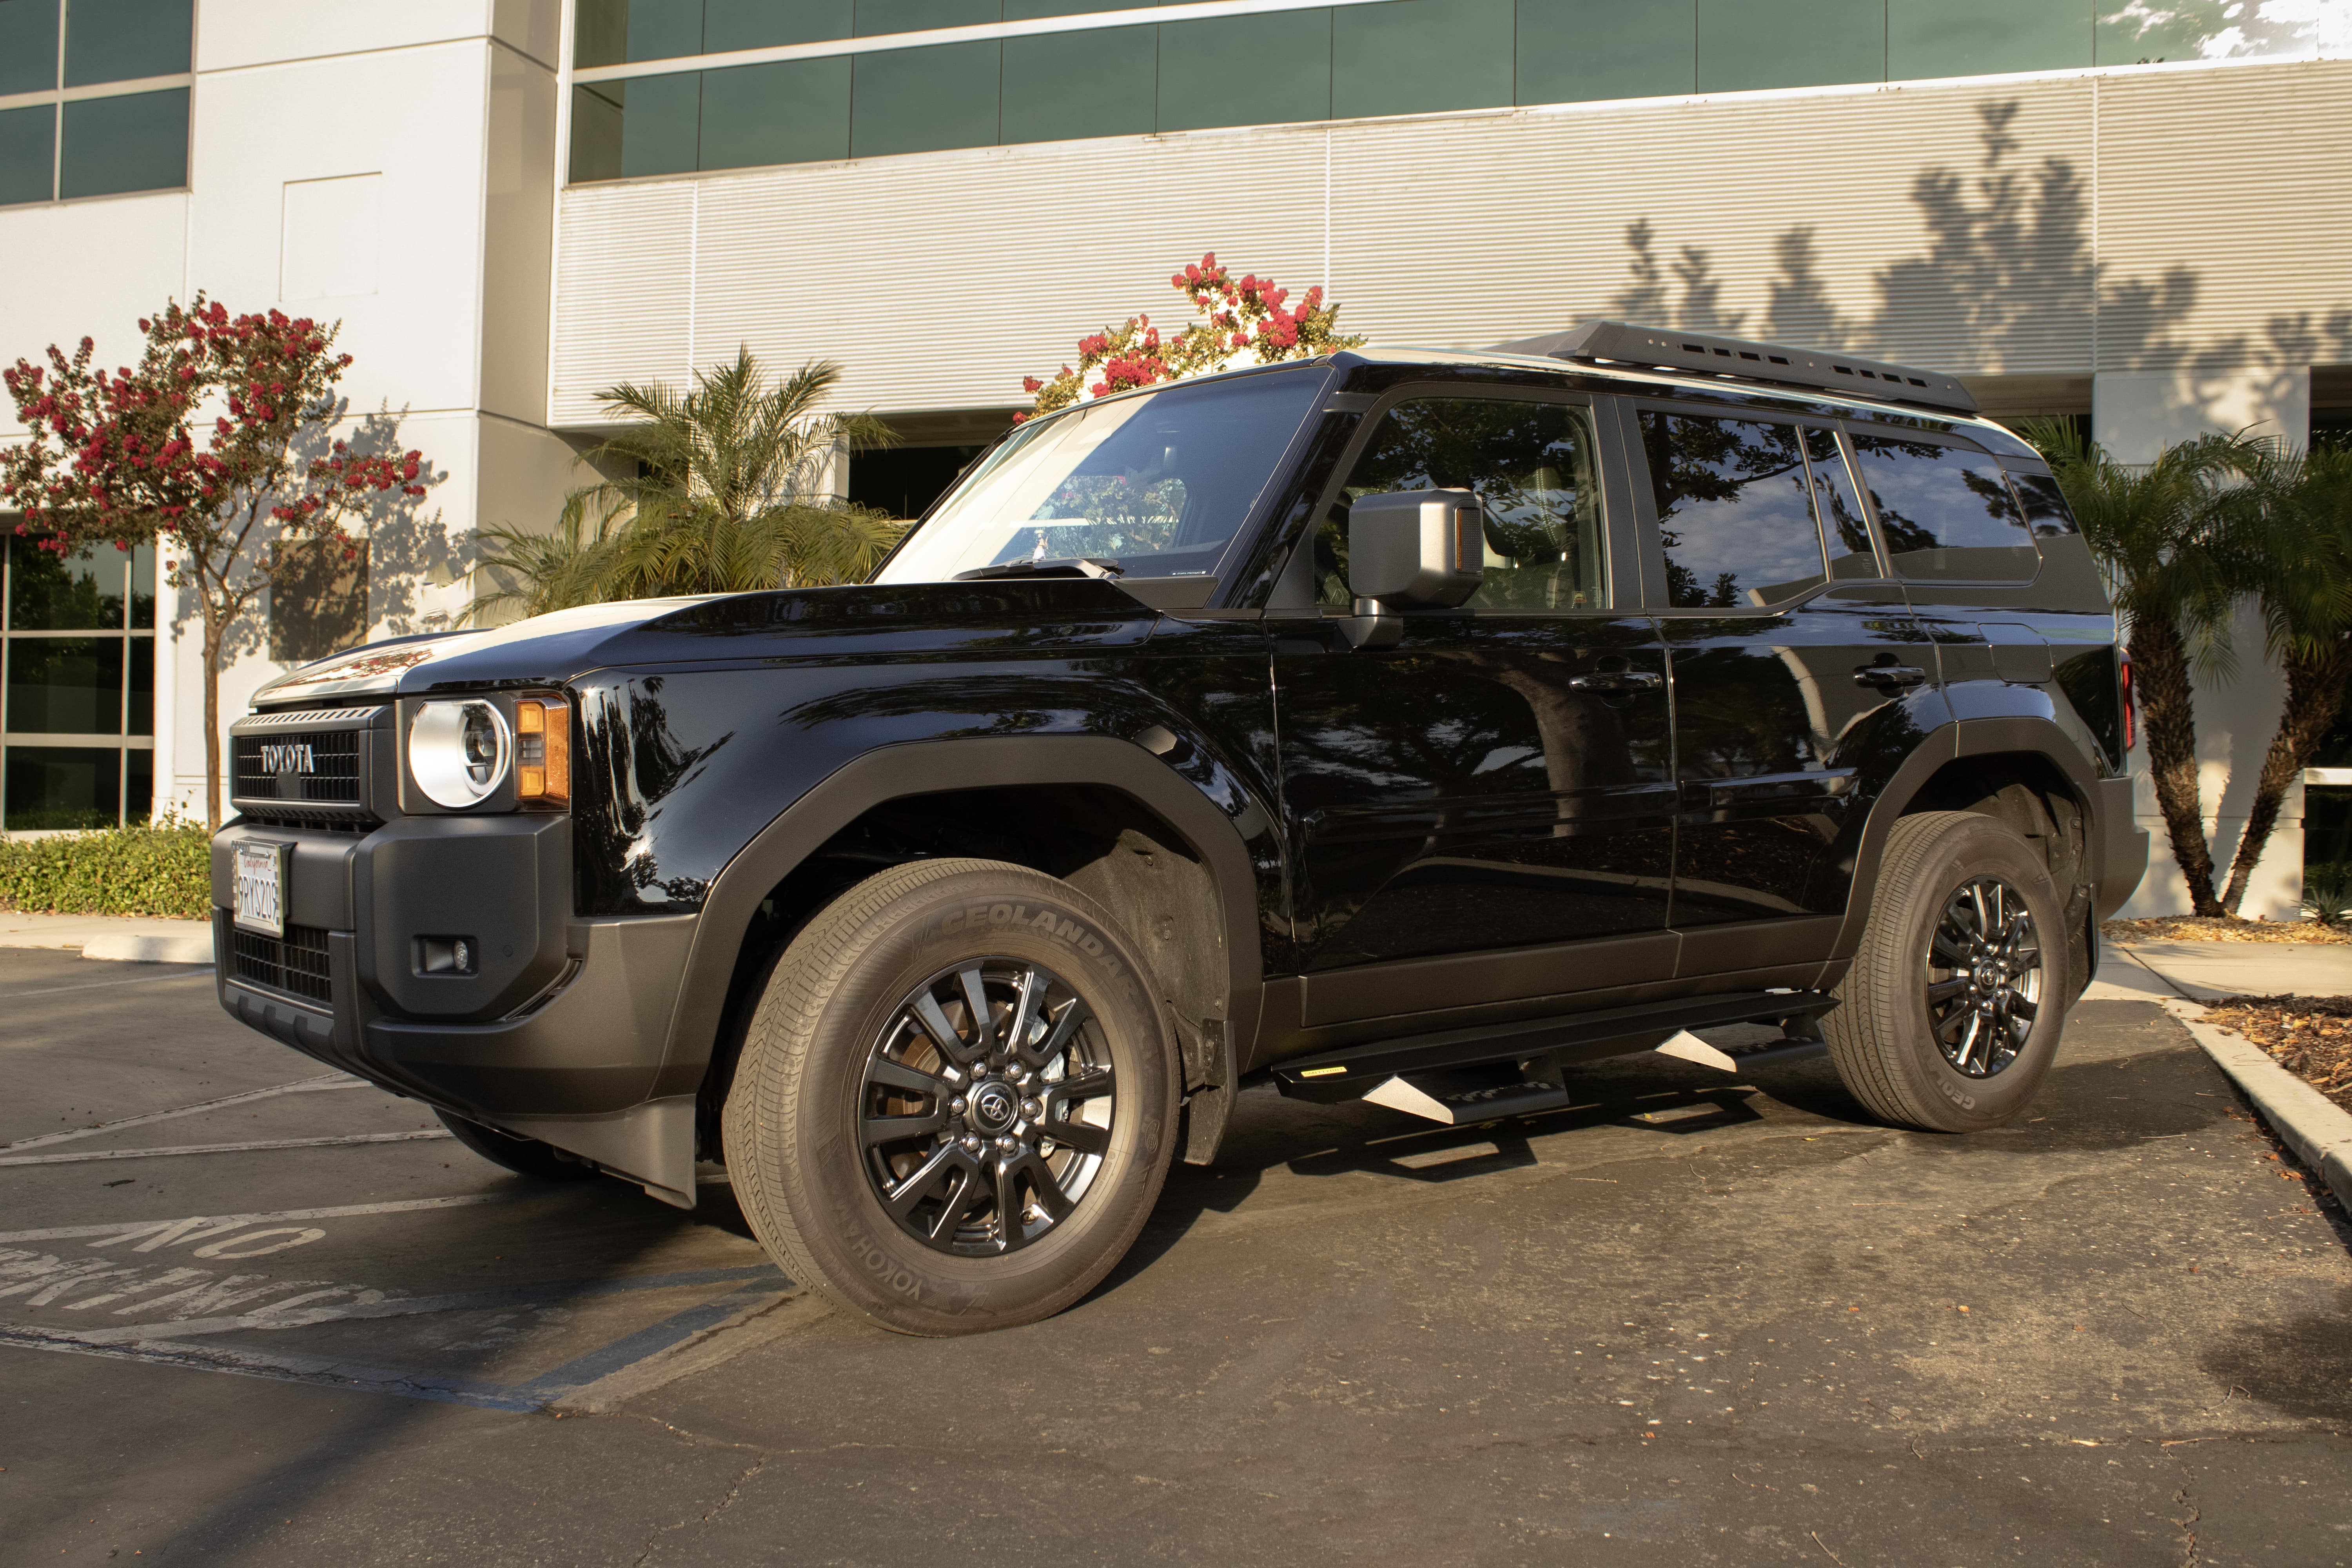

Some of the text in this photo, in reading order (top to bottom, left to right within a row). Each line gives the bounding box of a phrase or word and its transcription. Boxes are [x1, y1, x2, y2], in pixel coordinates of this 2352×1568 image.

[261, 744, 314, 773] TOYOTA
[239, 875, 276, 920] 9RYS209
[940, 903, 1139, 1000] GEOLANDAR
[86, 1216, 326, 1259] NO
